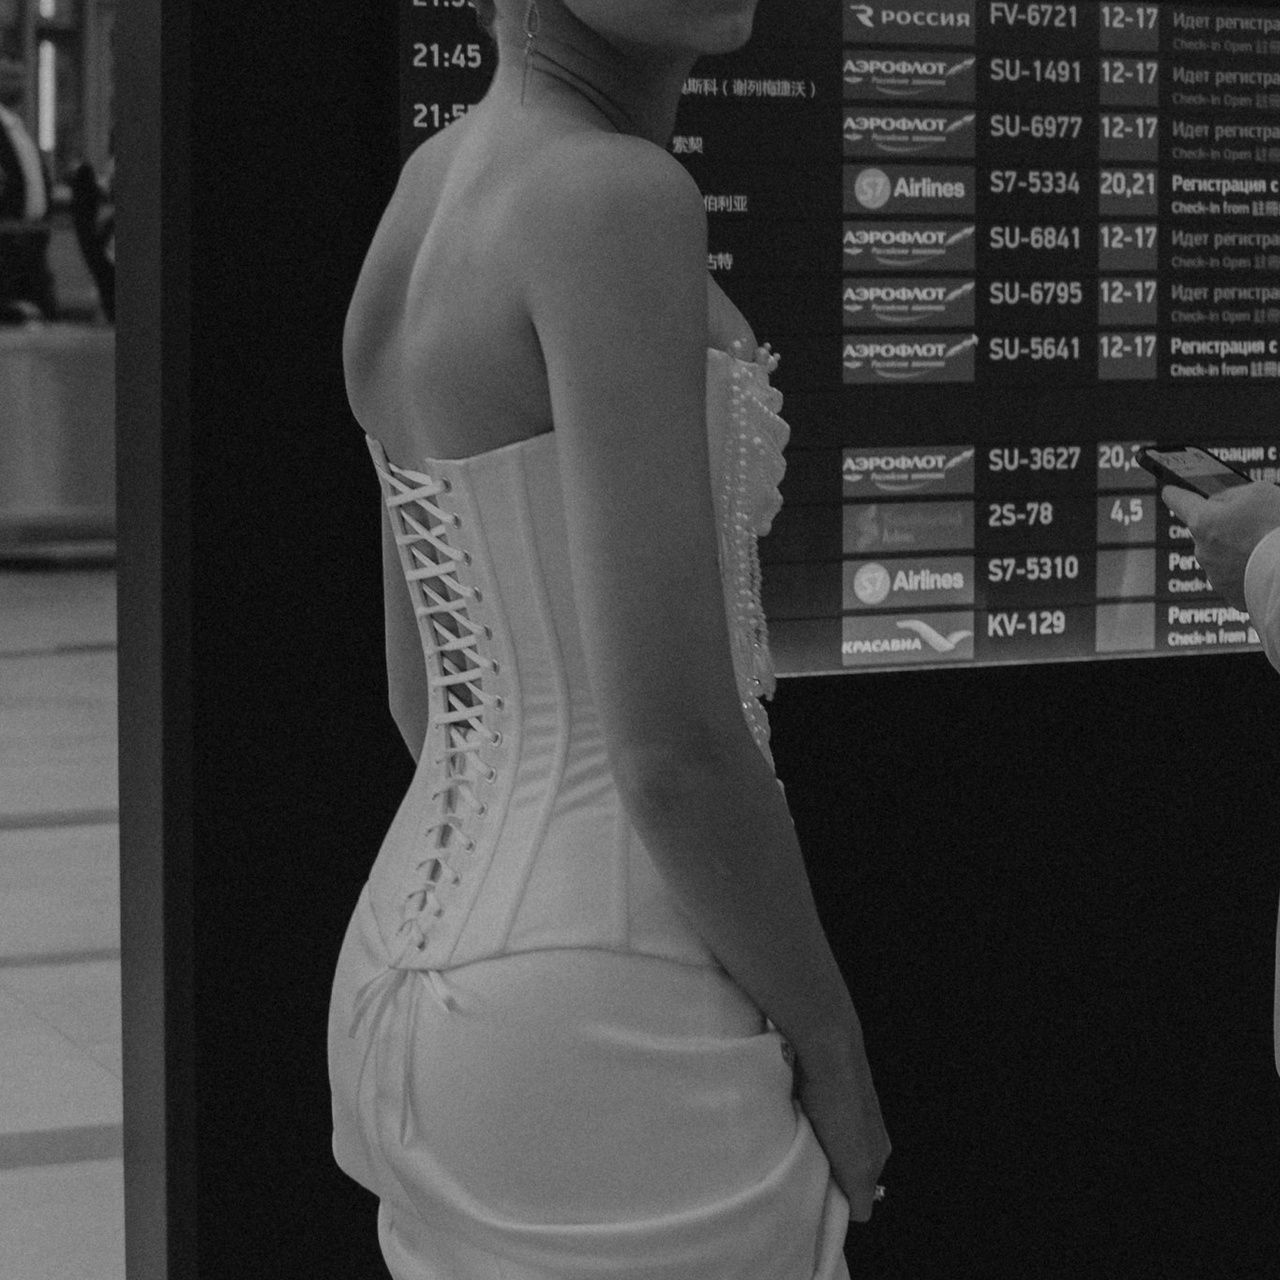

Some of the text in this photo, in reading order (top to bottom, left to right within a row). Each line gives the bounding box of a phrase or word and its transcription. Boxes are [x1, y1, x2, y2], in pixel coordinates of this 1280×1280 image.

[881, 10, 970, 27] РОССИЯ
[990, 1, 1077, 28] FV-6721
[1101, 6, 1158, 29] 12-17
[413, 42, 482, 68] 21:45
[843, 59, 948, 76] АЭРОФЛОТ
[990, 58, 1081, 83] SU-1491
[990, 114, 1083, 138] SU-6977
[894, 176, 965, 199] Airlines
[990, 170, 1080, 195] S7-5334
[1100, 171, 1155, 198] 20,21
[1172, 174, 1266, 196] Регистрация
[1270, 179, 1279, 193] с
[990, 226, 1080, 250] SU-6841
[990, 281, 1083, 305] SU-6795
[843, 343, 946, 359] АЭРОФЛОТ
[989, 336, 1079, 361] SU-5641
[1100, 335, 1157, 359] 12-17
[1170, 337, 1265, 358] Регистрация
[1268, 341, 1277, 354] с
[988, 446, 1081, 472] SU-3627
[988, 502, 1053, 527] 2S-78
[1109, 498, 1143, 525] 4,5
[988, 555, 1079, 582] S7-5310
[987, 610, 1065, 637] KV-129
